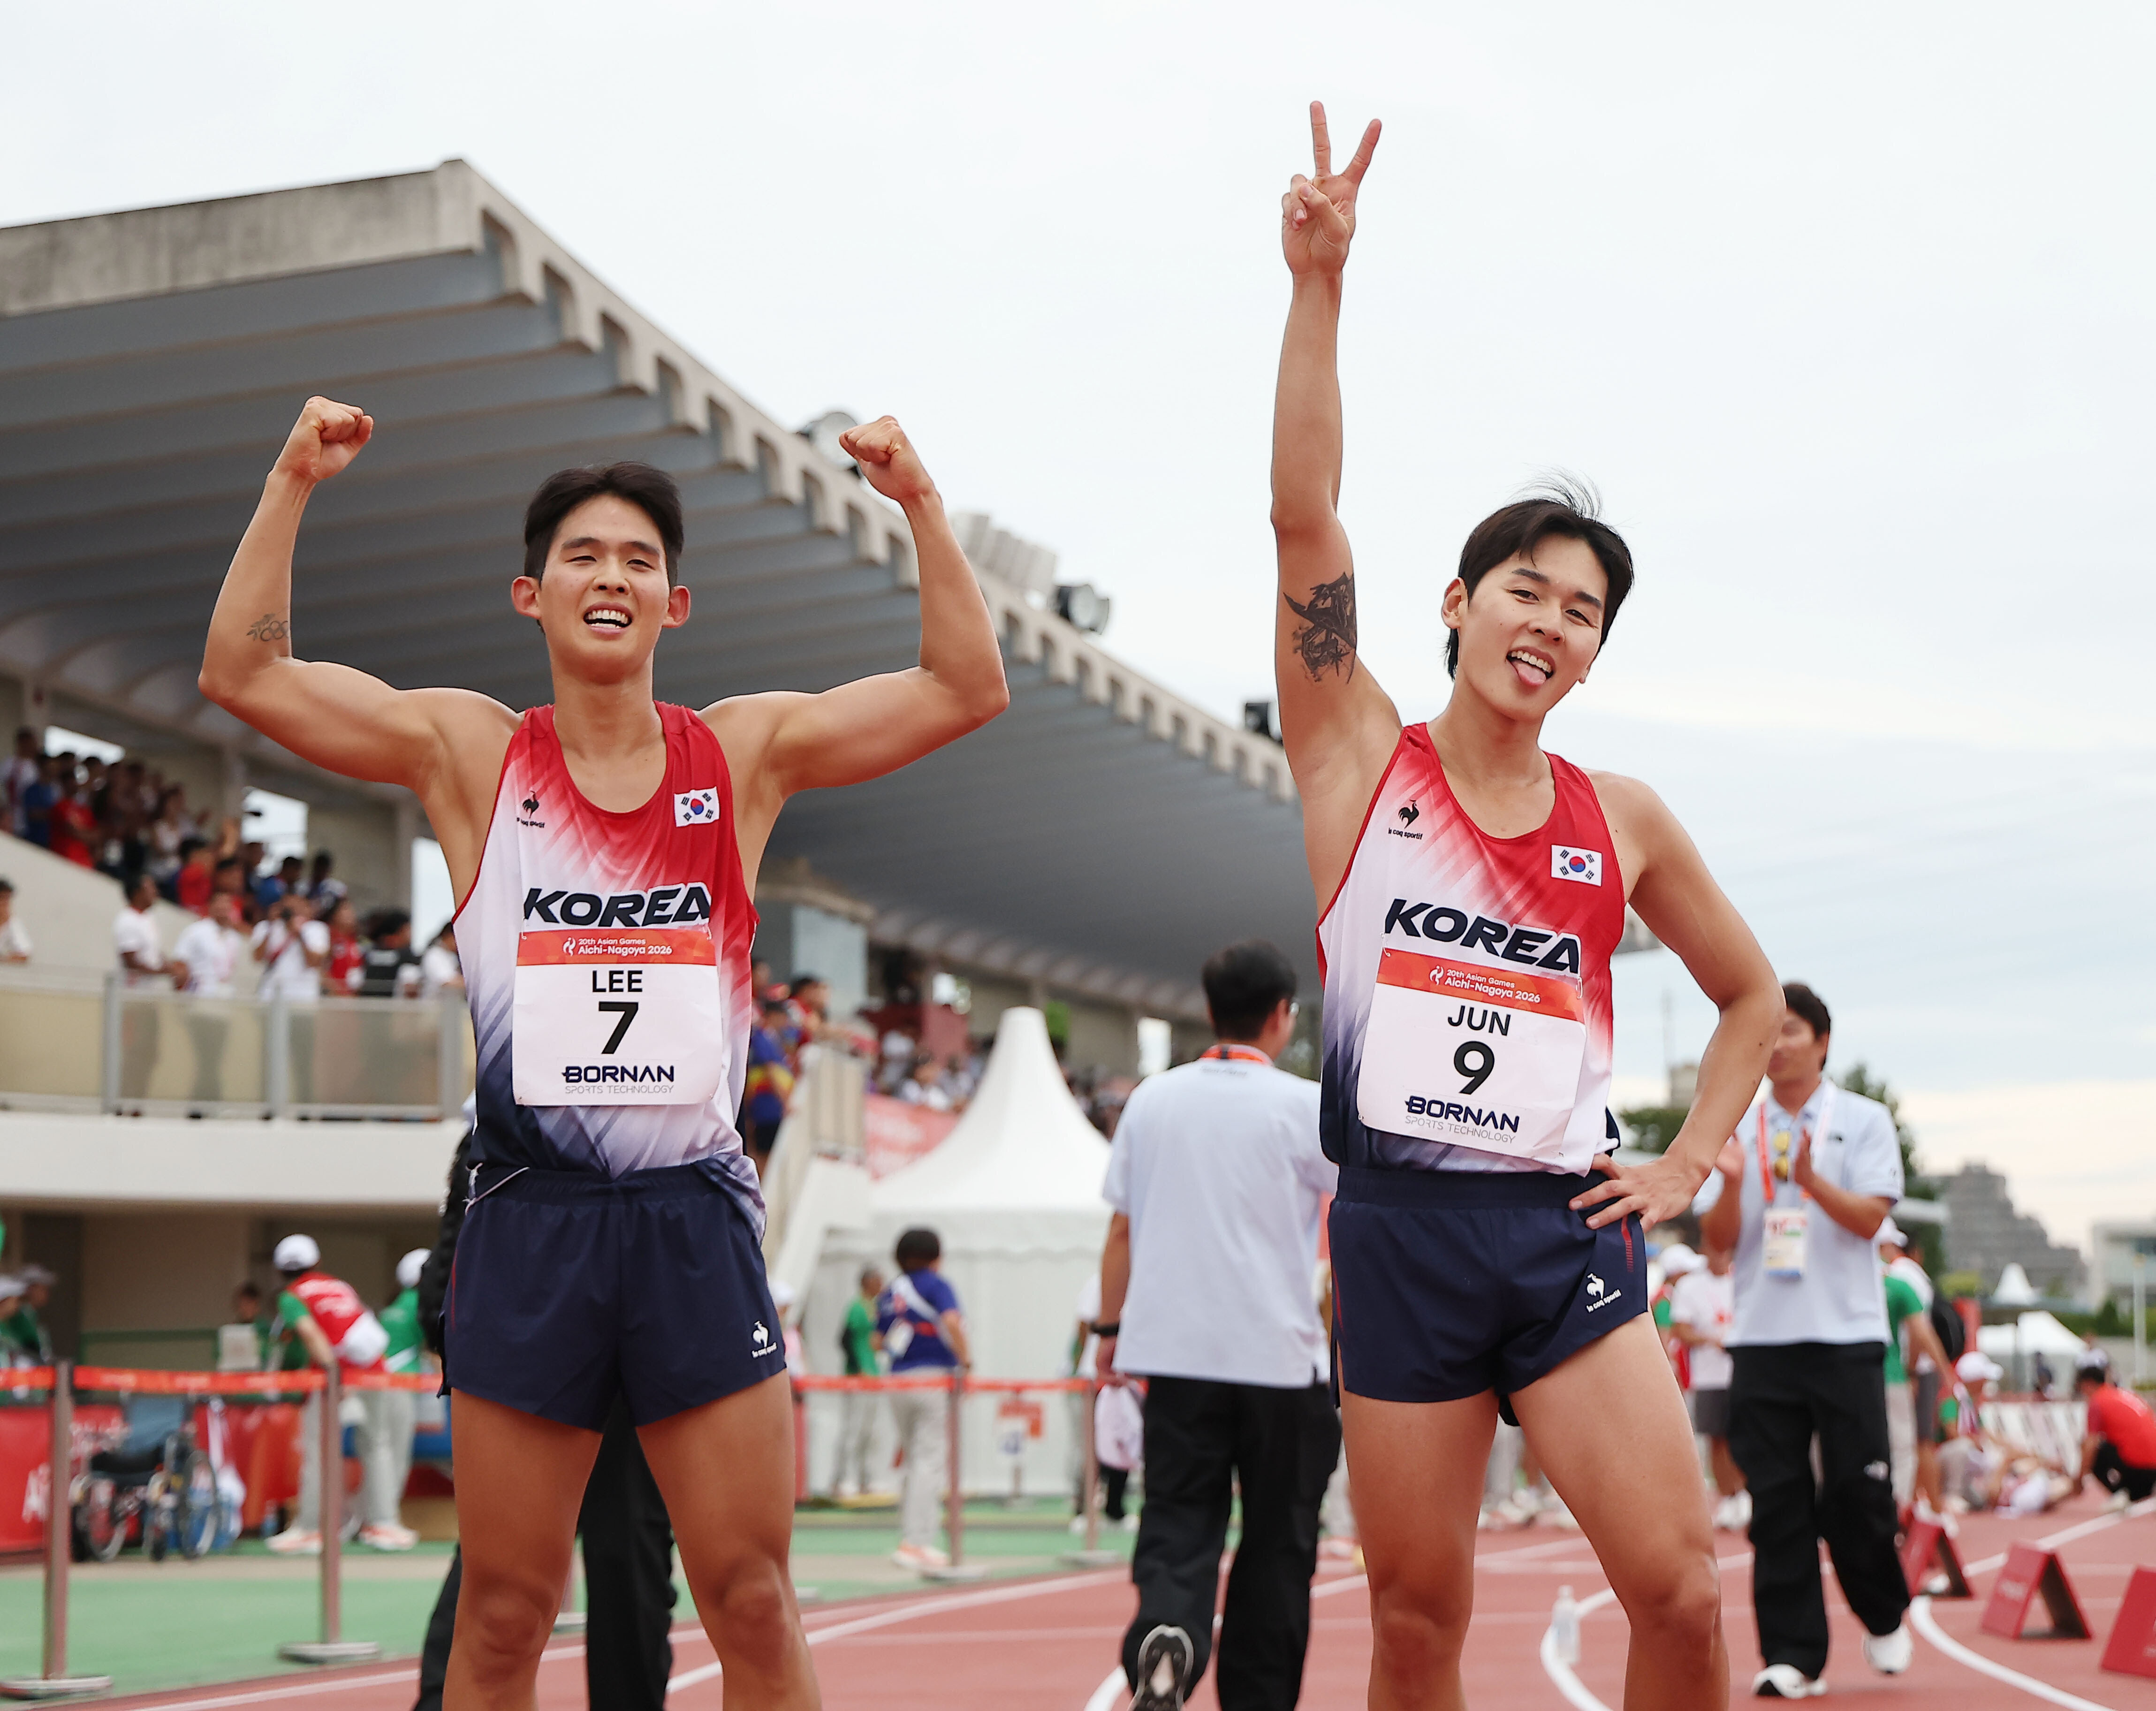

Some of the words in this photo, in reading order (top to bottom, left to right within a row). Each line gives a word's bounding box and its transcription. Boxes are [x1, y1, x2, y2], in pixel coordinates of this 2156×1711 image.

[1393, 829, 1403, 837] coq
[1404, 831, 1423, 840] sportif
[524, 886, 710, 927] KOREA
[1385, 898, 1579, 974] KOREA
[578, 945, 645, 957] Aichi-Nagoya
[647, 945, 673, 955] 2026
[592, 970, 643, 992] LEE
[1444, 977, 1513, 998] Aichi-Nagoya
[1515, 990, 1541, 1003] 2026
[1447, 969, 1465, 978] 20th
[1465, 973, 1487, 983] Asian
[1488, 977, 1515, 988] Games
[599, 1001, 639, 1054] 7
[1448, 1005, 1511, 1036] JUN
[562, 1065, 674, 1083] BORNAN
[1453, 1041, 1495, 1095] 9
[565, 1085, 603, 1094] SPORTS
[607, 1085, 675, 1094] TECHNOLOGY
[1404, 1095, 1519, 1133] BORNAN
[1405, 1115, 1443, 1130] SPORTS
[1448, 1123, 1516, 1143] TECHNOLOGY
